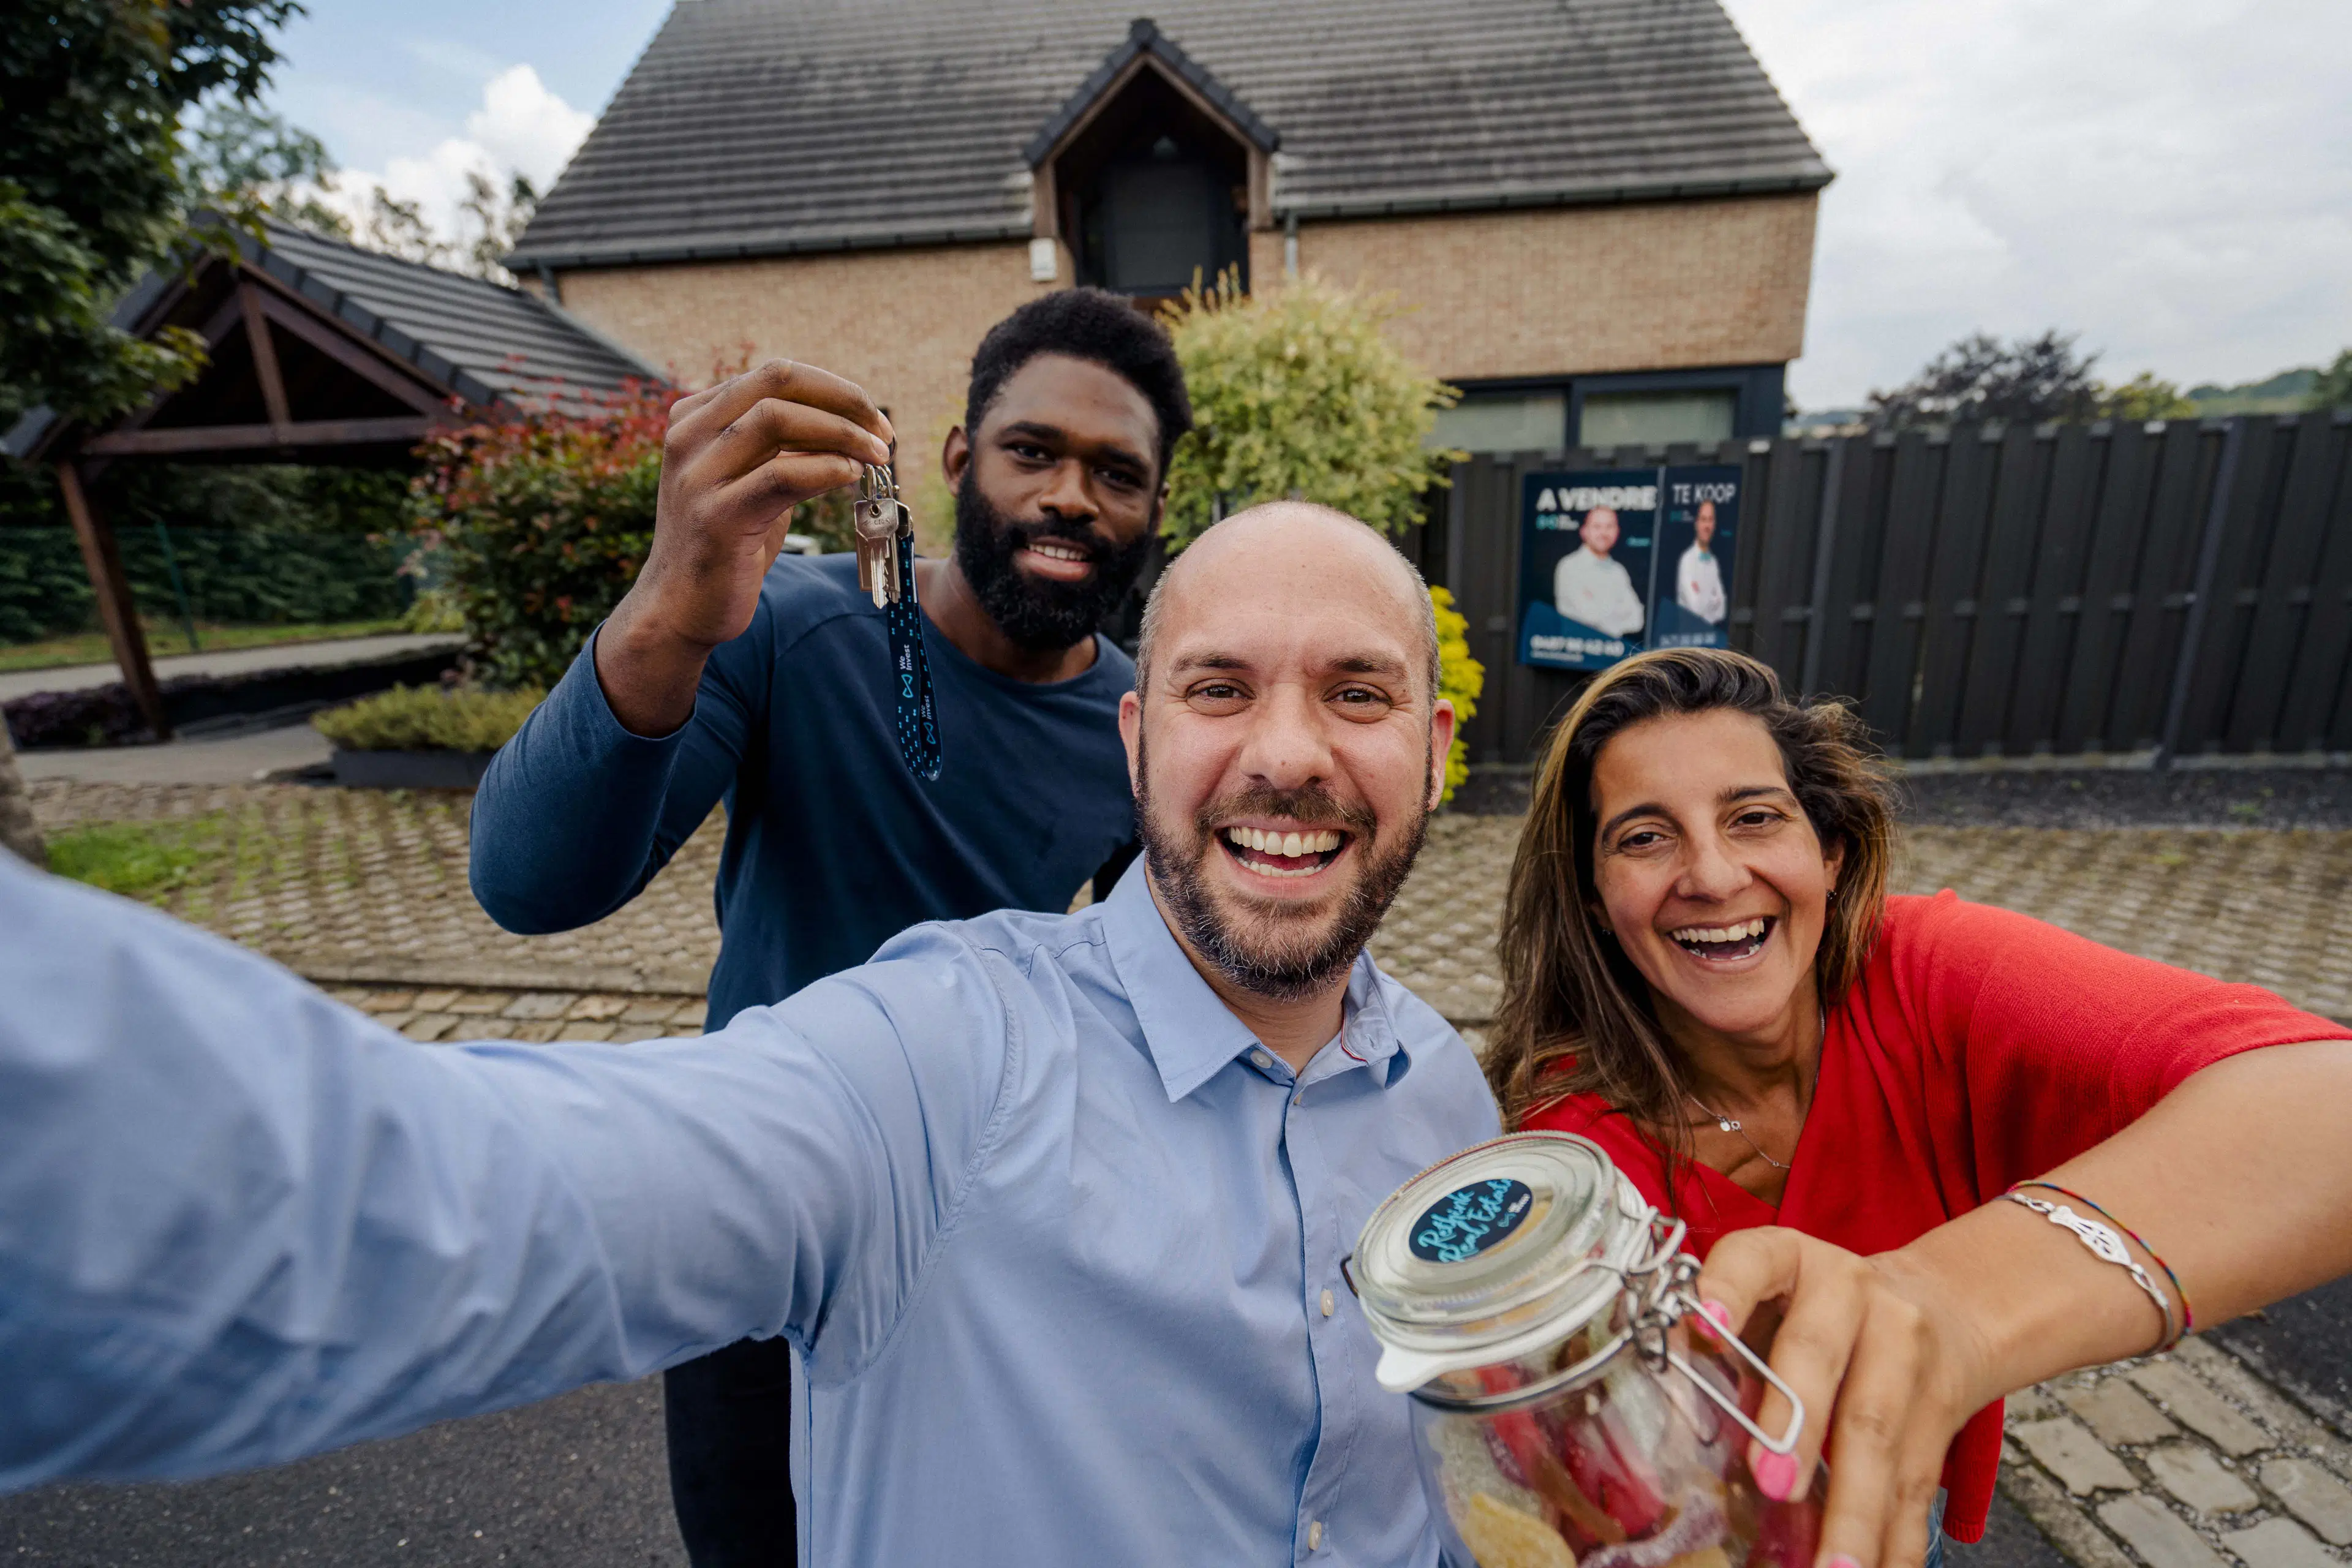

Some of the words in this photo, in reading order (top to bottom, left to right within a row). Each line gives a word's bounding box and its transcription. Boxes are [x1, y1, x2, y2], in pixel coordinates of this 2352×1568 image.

[1536, 488, 1557, 511] A
[1559, 486, 1657, 510] VENDRE
[1672, 483, 1691, 504] TE
[1694, 483, 1736, 504] KOOP
[899, 655, 907, 670] We
[903, 644, 913, 671] Invest
[920, 704, 927, 718] We
[924, 694, 932, 720] Invest
[1417, 1191, 1475, 1247] Rethink
[1438, 1221, 1490, 1263] Real
